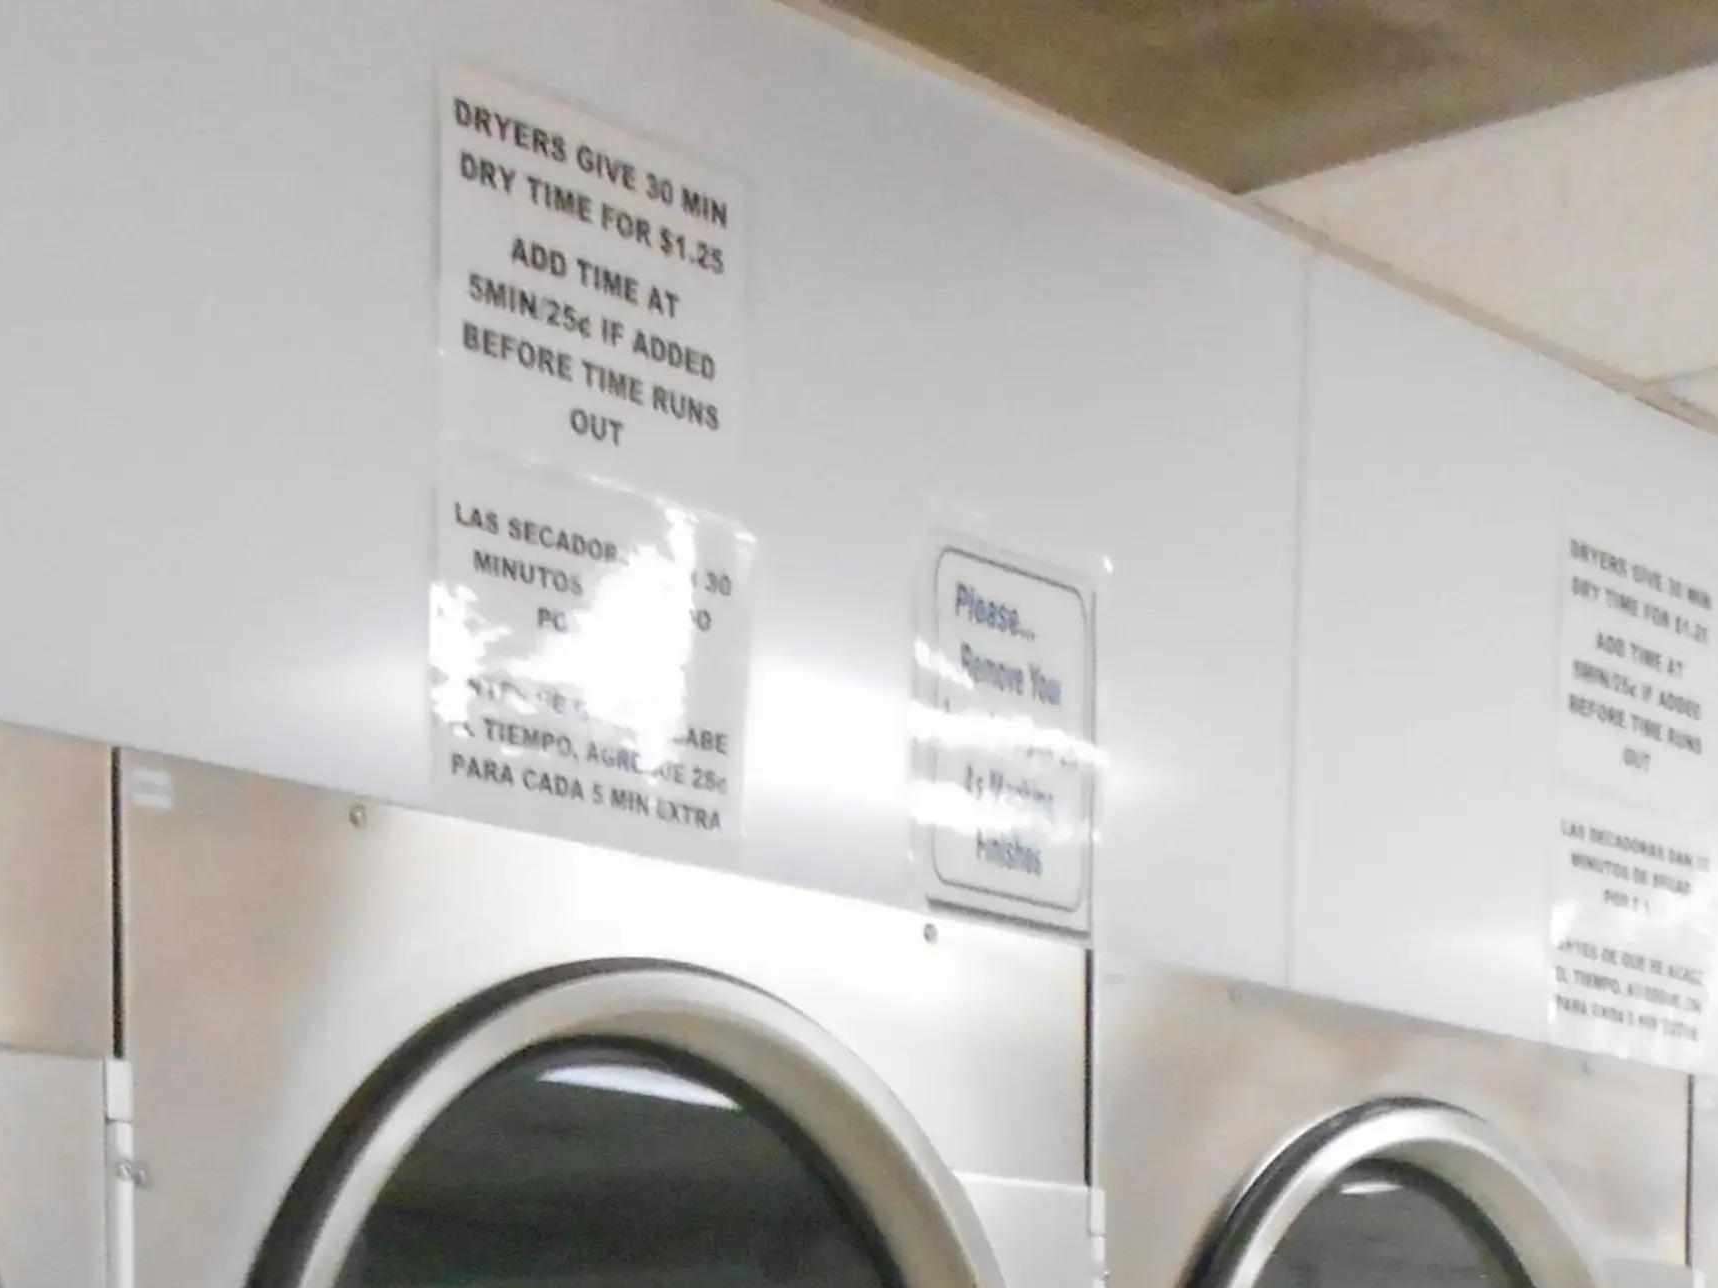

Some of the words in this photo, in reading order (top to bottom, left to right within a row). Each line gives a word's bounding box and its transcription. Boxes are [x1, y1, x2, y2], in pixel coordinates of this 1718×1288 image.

[453, 98, 567, 163] DRYERS
[576, 145, 636, 191] GIVE
[645, 172, 674, 207] 30
[681, 184, 728, 229] MIN
[459, 150, 516, 193] DRY
[527, 176, 593, 223] TIME
[601, 202, 651, 246] FOR
[659, 226, 724, 274] $1.25
[511, 238, 567, 278] ADD
[576, 258, 639, 304] TIME
[647, 286, 680, 318] AT
[463, 321, 573, 381] BEFORE
[581, 359, 644, 405] TIME
[652, 385, 719, 431] RUNS
[602, 317, 624, 347] IF
[632, 329, 716, 381] ADDED
[570, 407, 624, 447] OUT
[454, 502, 498, 535] LAS
[508, 517, 619, 563] SECADOR
[704, 570, 732, 597] 30
[473, 549, 584, 597] MINUTOS
[451, 753, 514, 787] PARA
[522, 769, 584, 801] CADA
[592, 783, 604, 805] 5
[610, 787, 649, 818] MIN
[656, 800, 723, 830] EXTRA
[586, 741, 685, 787] AGREUE
